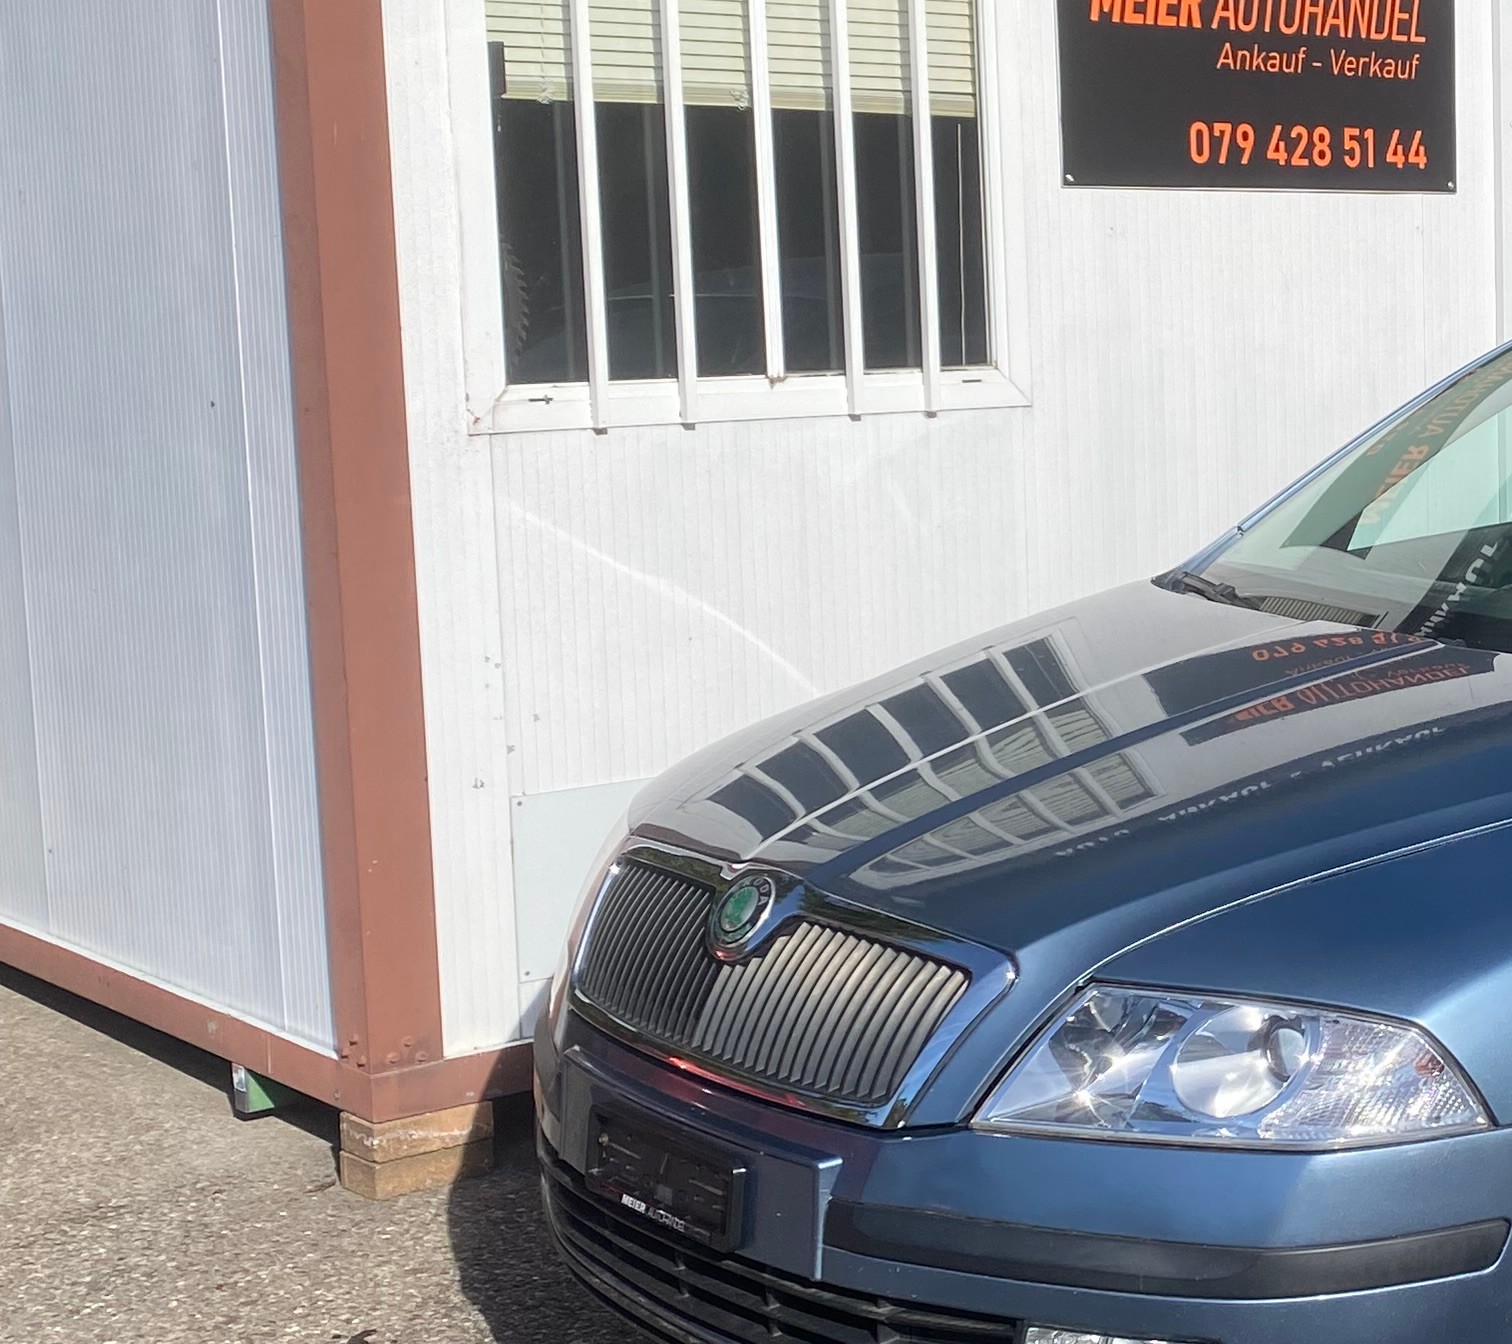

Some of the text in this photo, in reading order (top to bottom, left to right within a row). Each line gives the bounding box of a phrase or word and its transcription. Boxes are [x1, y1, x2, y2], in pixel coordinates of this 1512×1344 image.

[1216, 42, 1307, 74] Ankauf
[1330, 48, 1420, 80] Verkauf
[1189, 121, 1427, 169] 079 428 51 44
